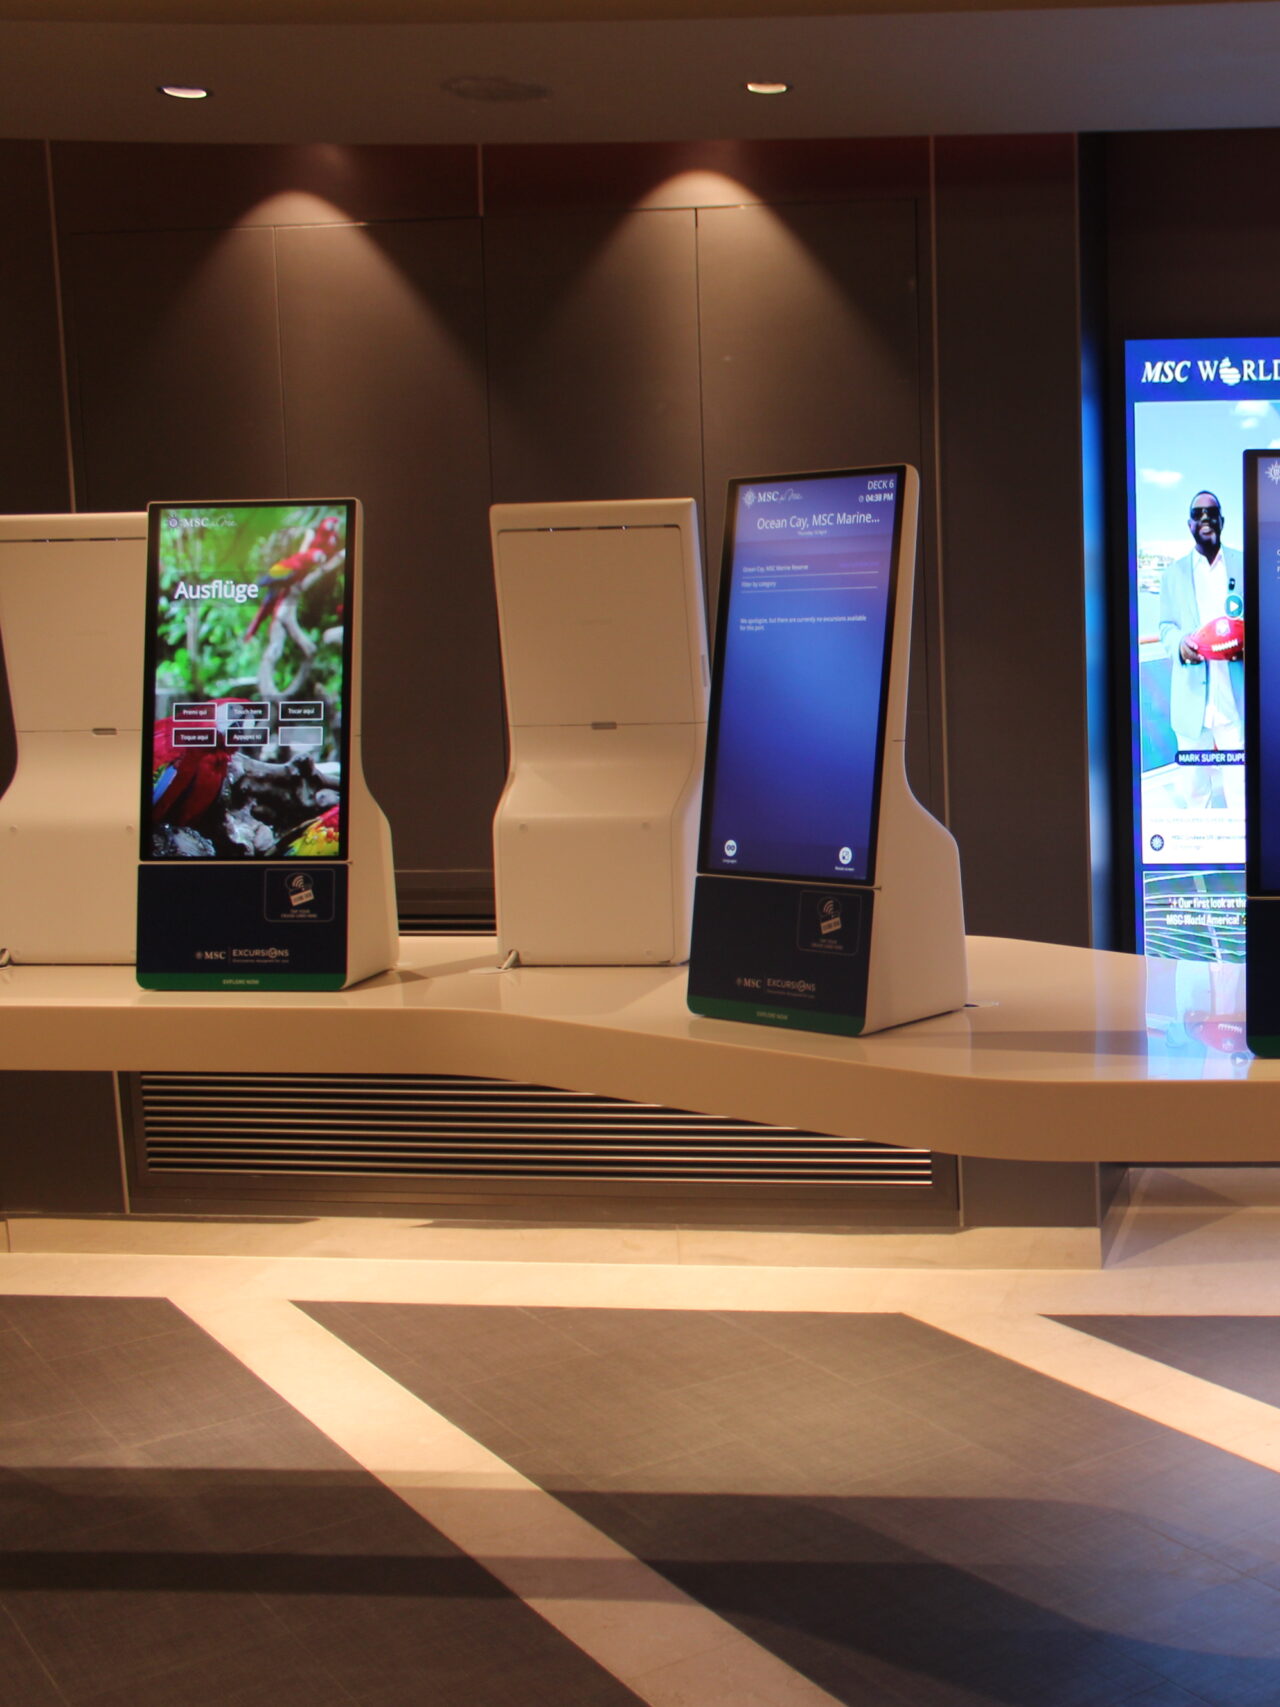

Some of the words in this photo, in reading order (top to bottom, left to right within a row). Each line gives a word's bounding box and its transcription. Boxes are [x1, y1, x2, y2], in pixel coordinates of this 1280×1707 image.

[1141, 361, 1190, 383] MSC
[867, 480, 887, 490] DECK
[889, 480, 894, 488] 6
[757, 491, 779, 502] MSC
[883, 493, 893, 501] PM
[182, 518, 209, 528] MSC
[757, 518, 787, 530] Ocean
[790, 516, 808, 531] Cay,
[812, 513, 834, 526] MSC
[174, 579, 259, 603] Ausflüge
[1178, 753, 1200, 762] MARK
[1201, 753, 1225, 762] SUPER
[1178, 897, 1192, 908] Our
[1193, 897, 1209, 908] first
[1210, 897, 1226, 908] look
[1226, 898, 1235, 908] at
[1166, 914, 1183, 925] MSC
[1184, 914, 1206, 925] World
[1207, 913, 1240, 925] America!
[204, 951, 226, 960] MSC
[232, 947, 289, 959] EXCURSIONS
[743, 977, 762, 989] MSC
